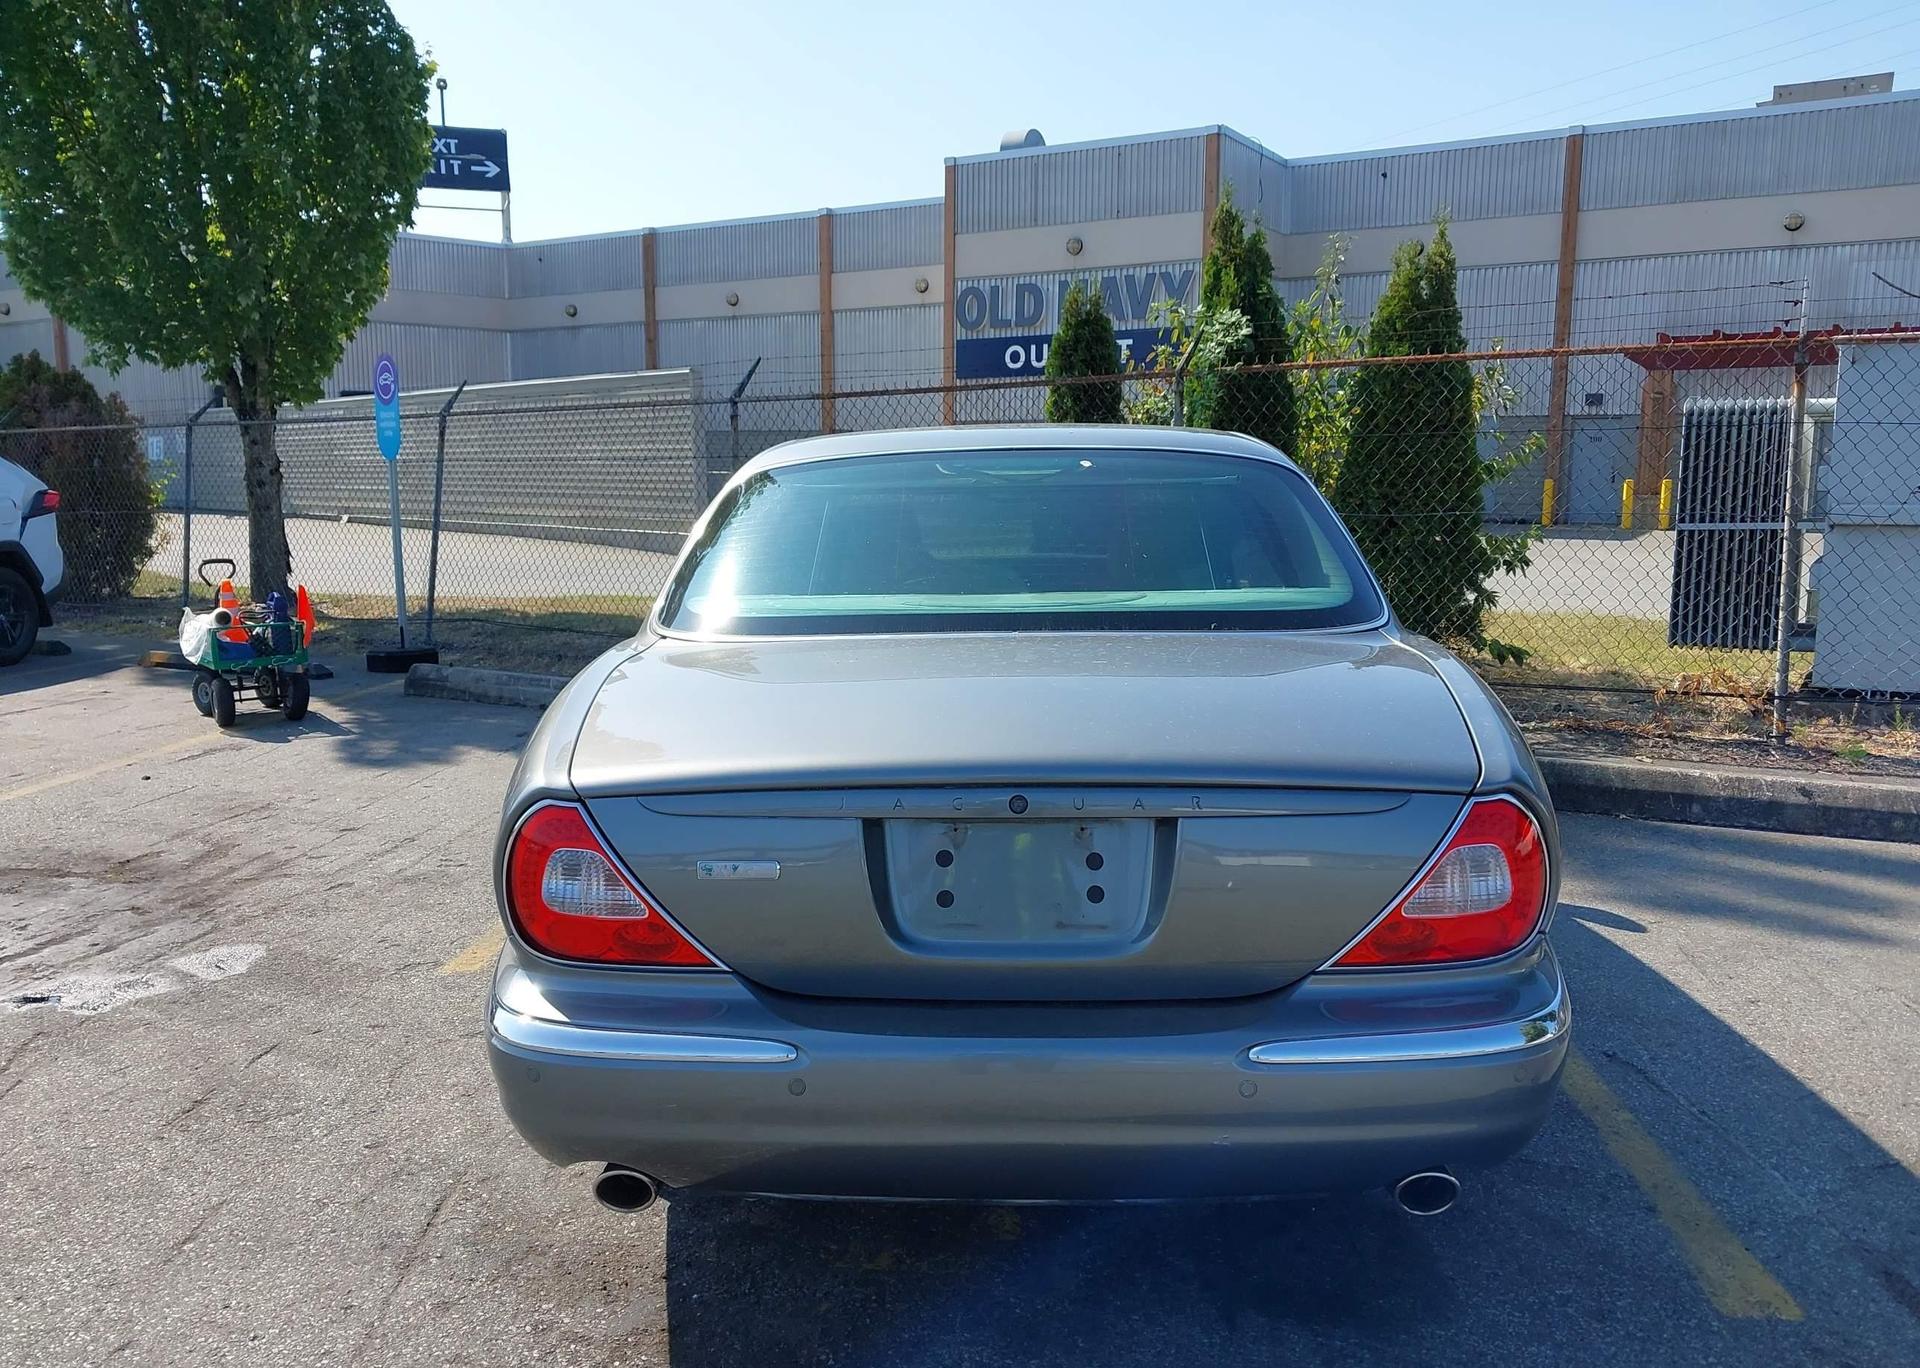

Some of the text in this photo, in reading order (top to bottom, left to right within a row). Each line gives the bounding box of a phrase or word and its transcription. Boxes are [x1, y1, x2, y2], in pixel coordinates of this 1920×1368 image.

[432, 137, 459, 154] XT
[956, 283, 1046, 332] OLD
[1004, 338, 1134, 369] OUT
[838, 795, 1204, 812] JAGUAR
